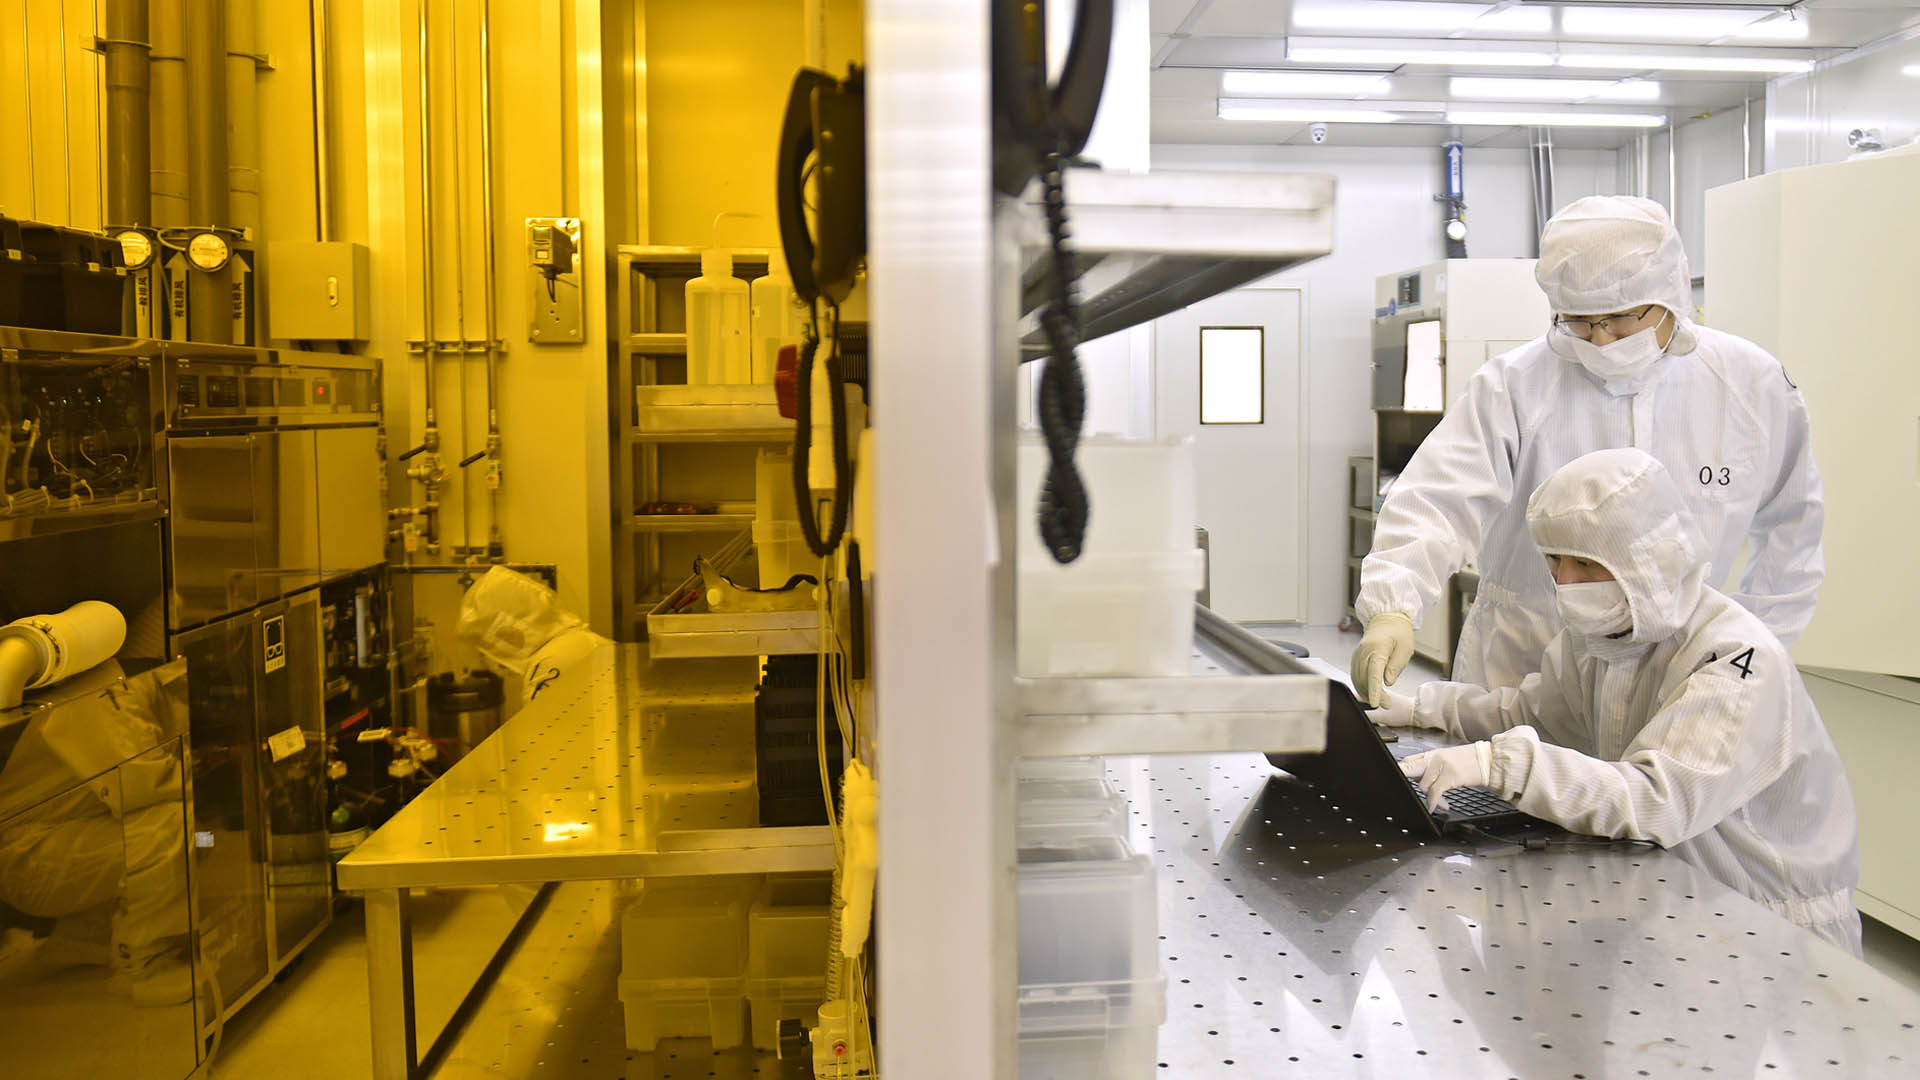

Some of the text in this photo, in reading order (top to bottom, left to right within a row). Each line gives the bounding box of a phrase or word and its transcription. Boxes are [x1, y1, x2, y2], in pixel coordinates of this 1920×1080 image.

[174, 280, 185, 318] 有机排风
[1699, 465, 1731, 486] 03
